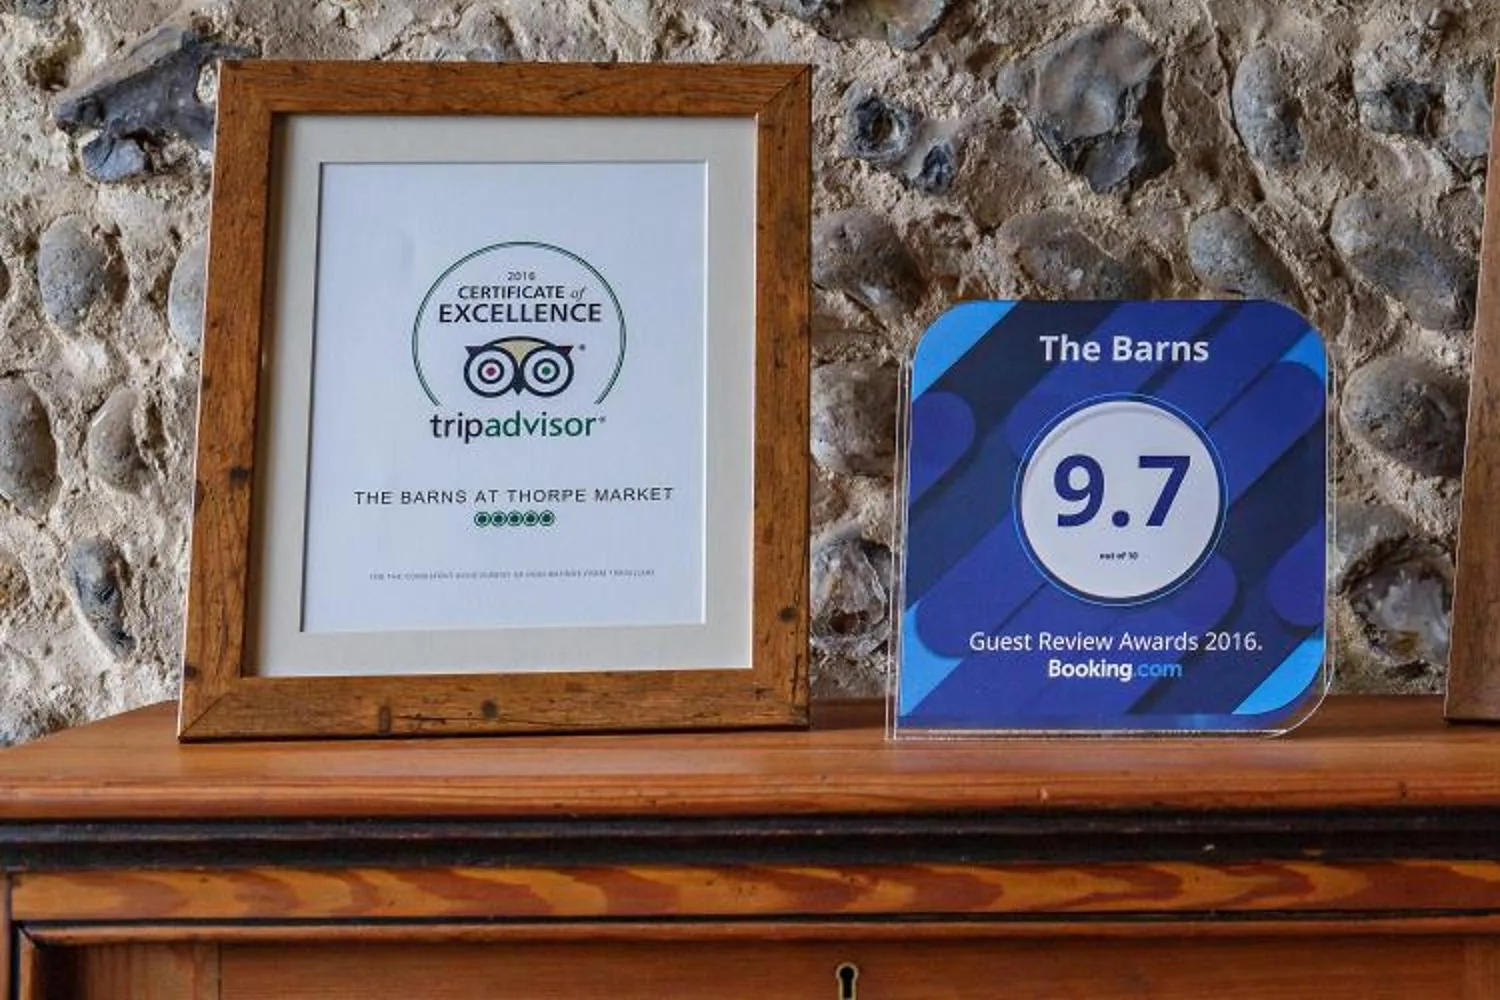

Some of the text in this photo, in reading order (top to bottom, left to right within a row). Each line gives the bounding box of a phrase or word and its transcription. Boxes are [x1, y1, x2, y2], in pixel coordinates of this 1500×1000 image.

[507, 272, 536, 281] 2016
[457, 286, 587, 302] CERTIFICATE of
[439, 304, 602, 322] EXCELLENCE
[1040, 335, 1209, 361] The Barns
[429, 410, 597, 444] tripadvisor
[353, 487, 675, 505] THE BARNS AT THORPE MARKET
[1053, 454, 1191, 528] 9.7
[1100, 551, 1139, 560] out of 10
[969, 631, 1263, 652] Guest Review Awards 2016.
[1048, 660, 1183, 682] Booking.com
